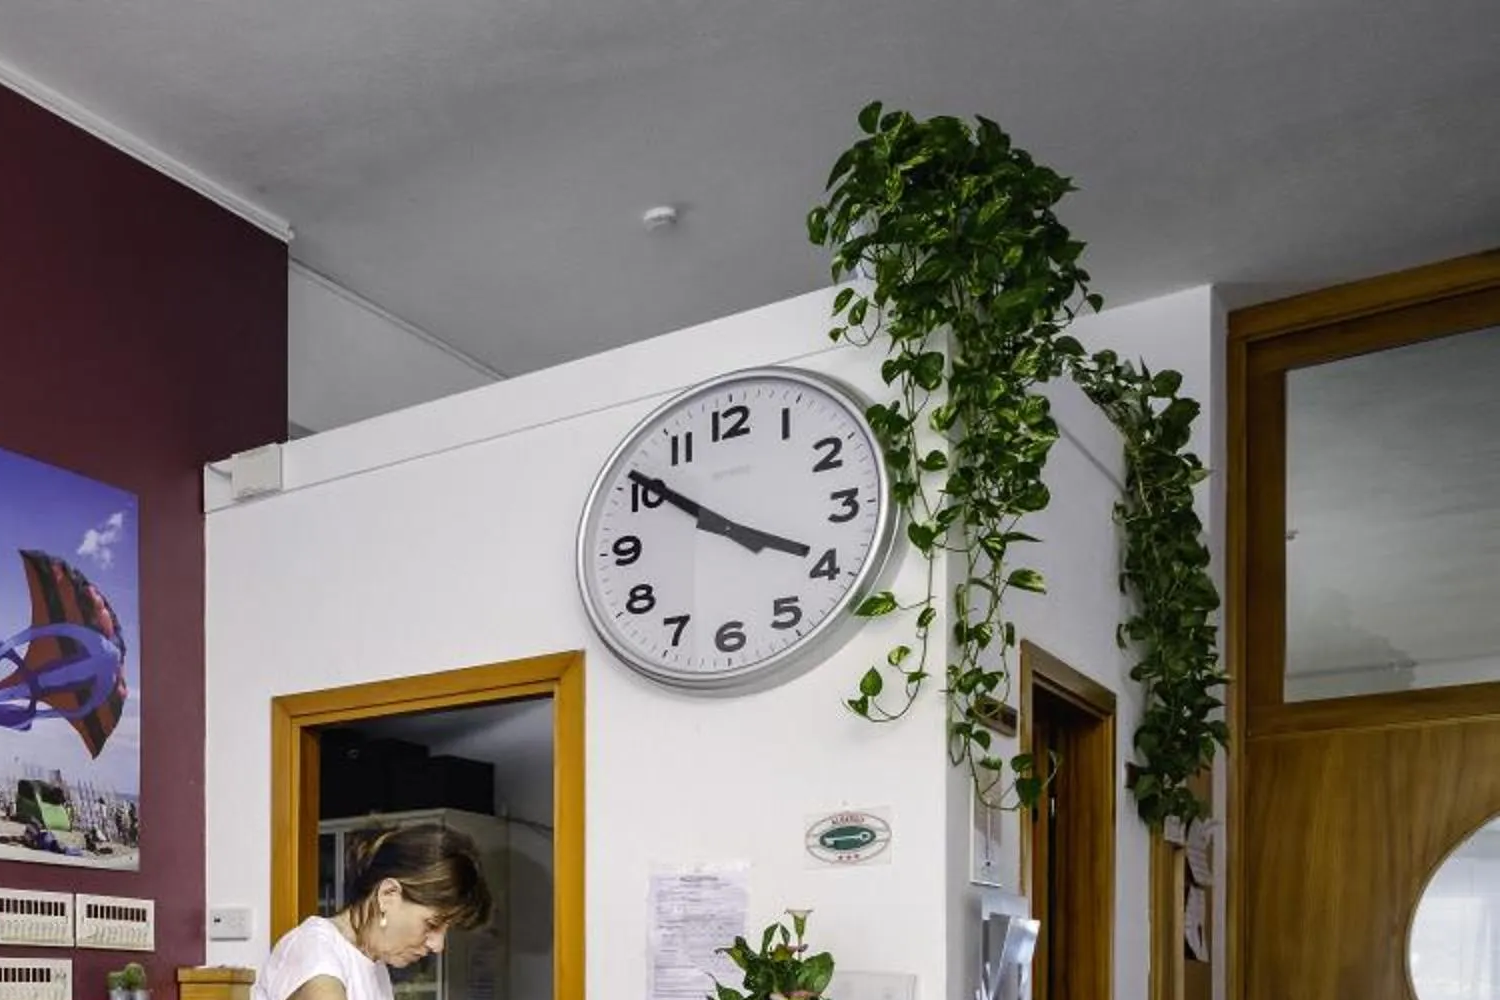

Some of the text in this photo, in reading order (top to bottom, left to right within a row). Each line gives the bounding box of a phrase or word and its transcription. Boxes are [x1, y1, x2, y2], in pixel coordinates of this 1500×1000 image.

[712, 405, 750, 442] 12
[781, 407, 791, 440] 1
[671, 432, 693, 466] 11
[812, 437, 843, 473] 2
[631, 476, 667, 513] 10
[828, 487, 860, 523] 3
[612, 535, 643, 567] 9
[809, 548, 841, 581] 4
[625, 583, 657, 615] 8
[770, 596, 803, 630] 5
[663, 614, 691, 647] 7
[715, 621, 747, 652] 6
